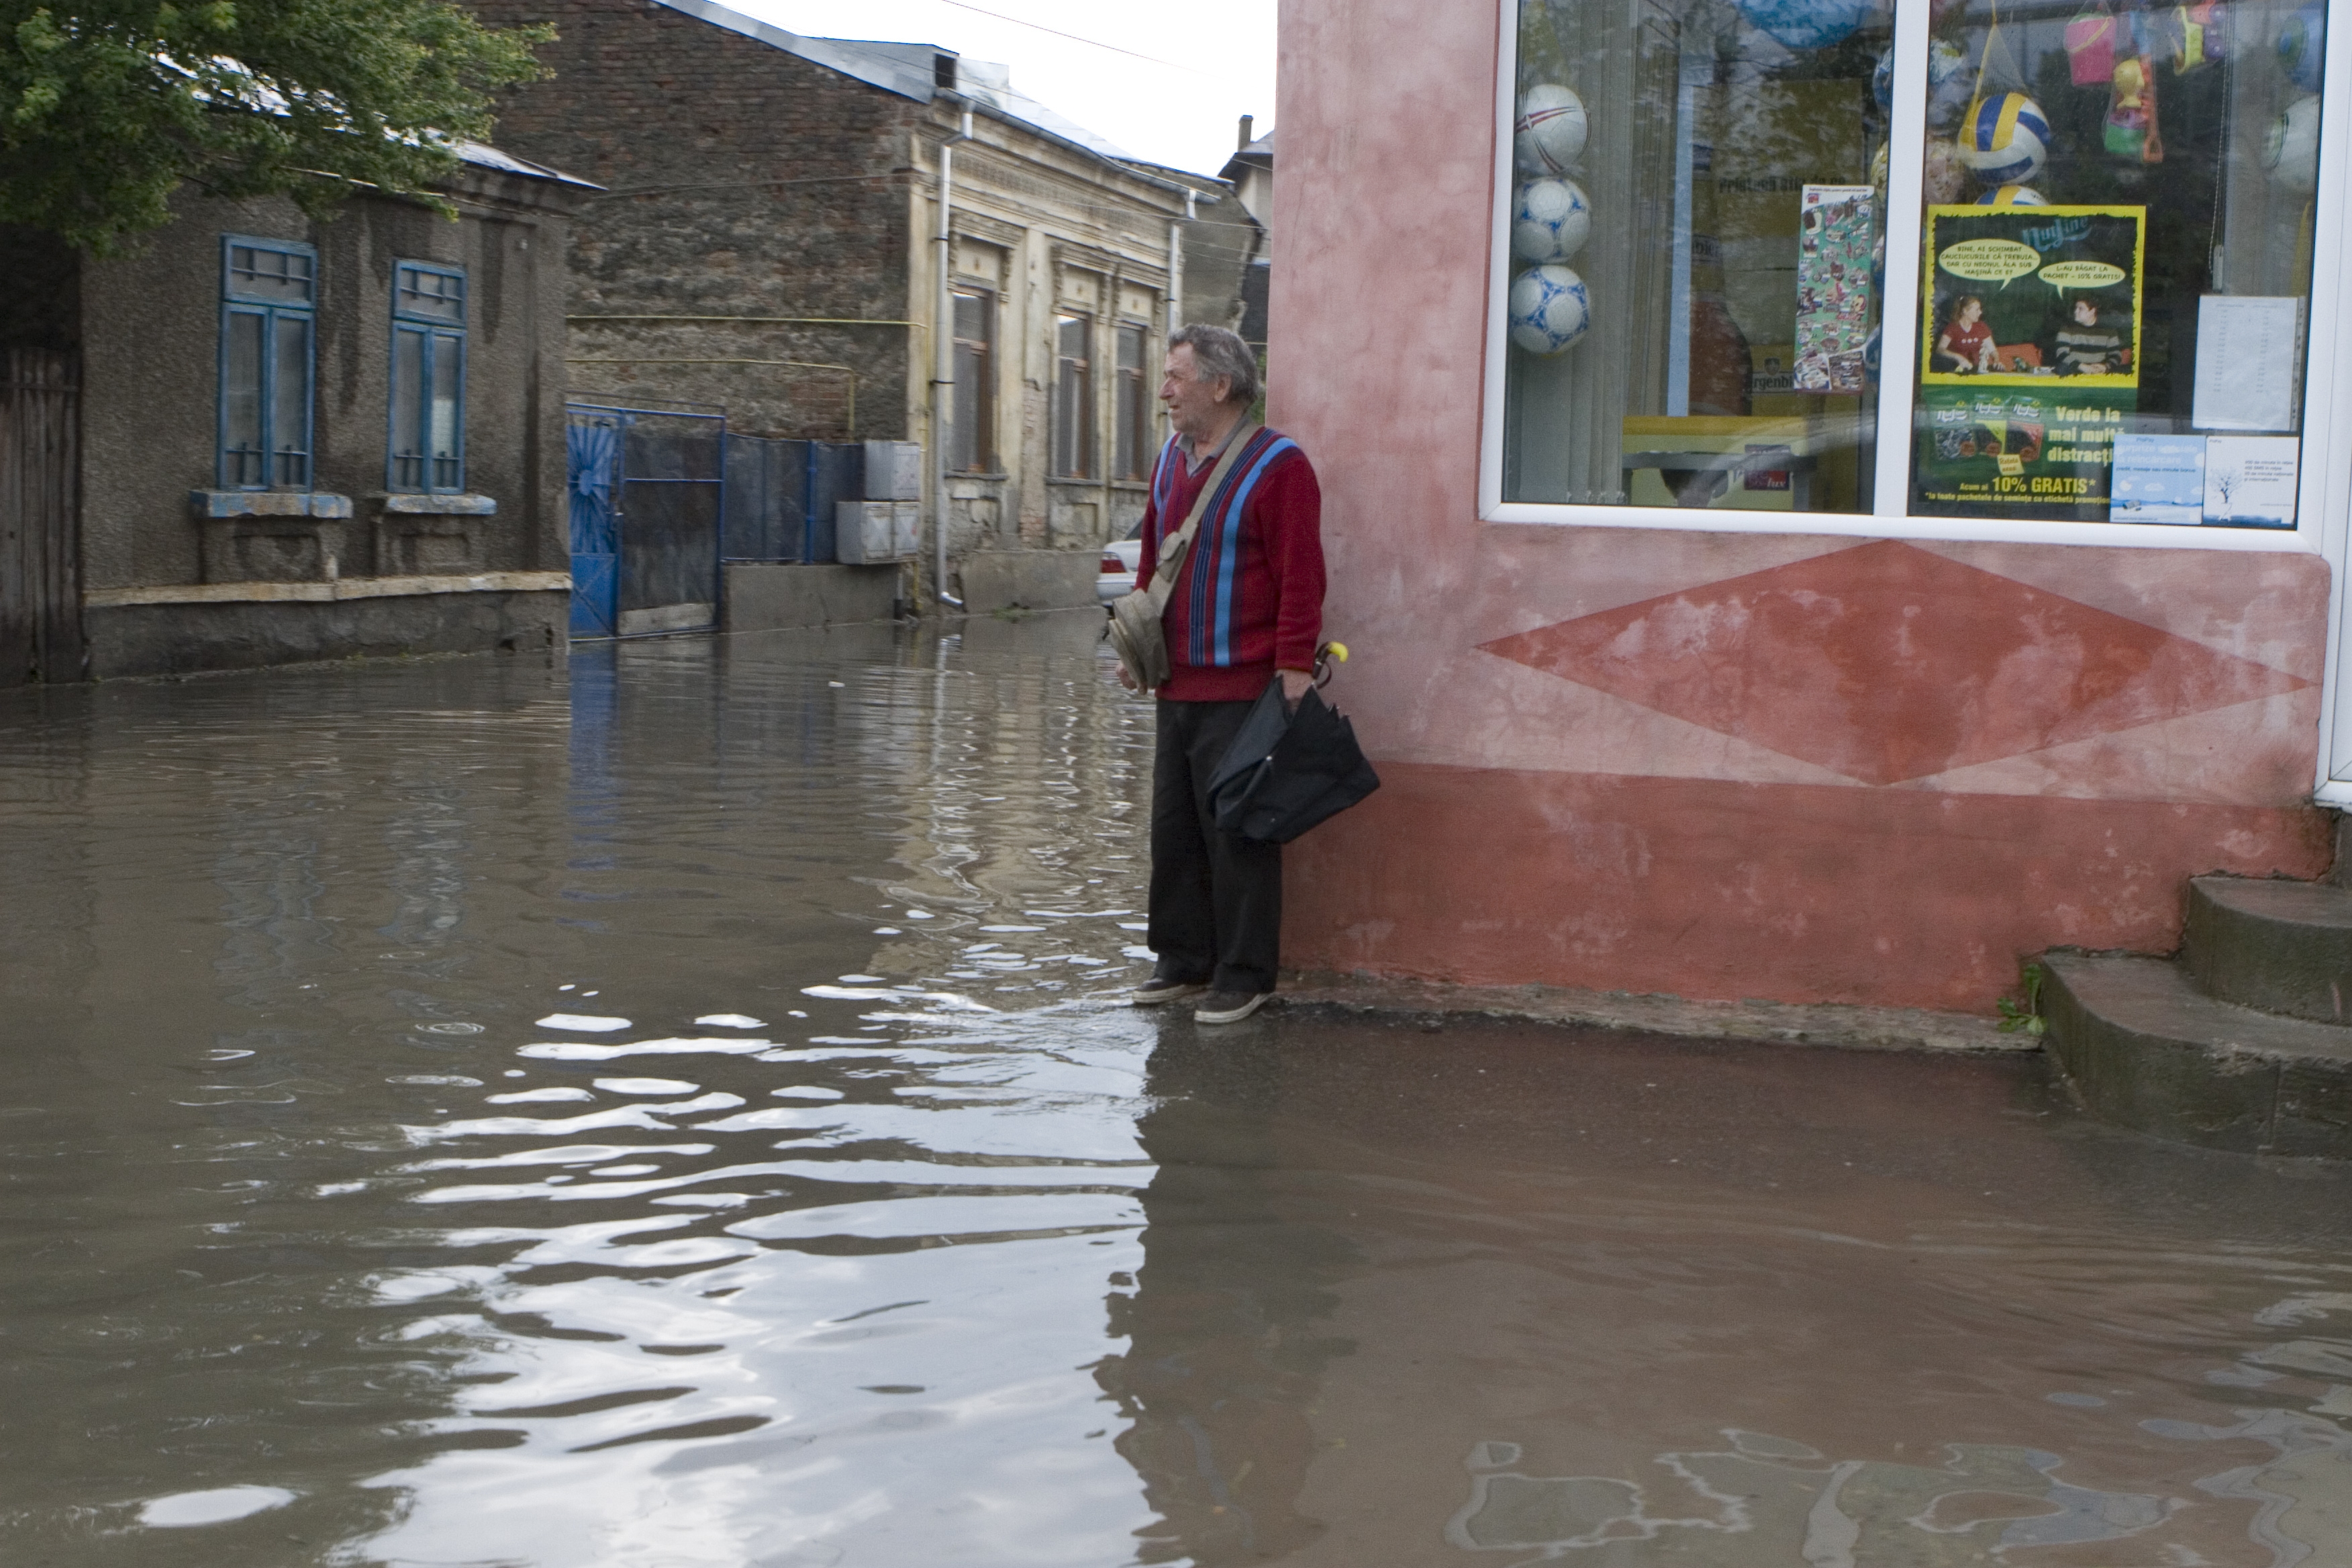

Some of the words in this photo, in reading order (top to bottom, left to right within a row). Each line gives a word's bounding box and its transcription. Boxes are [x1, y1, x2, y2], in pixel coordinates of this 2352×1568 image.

[2056, 405, 2101, 422] Verde
[2105, 407, 2120, 422] la
[2048, 426, 2077, 442] mai
[1959, 482, 1980, 491] Acum
[1992, 476, 2026, 493] 10%
